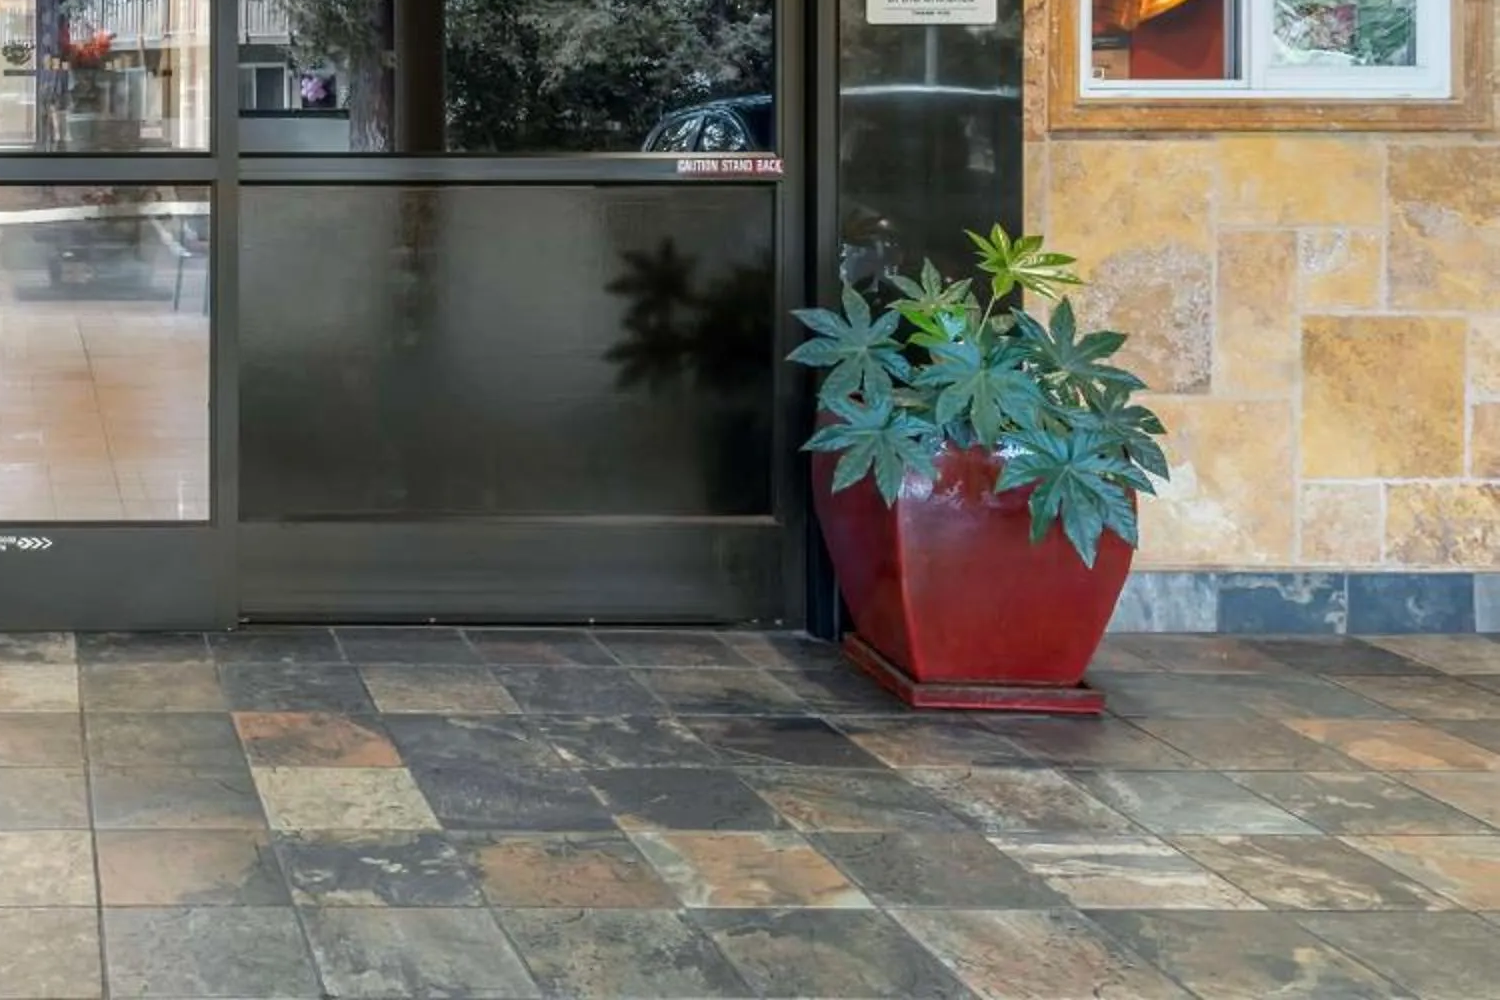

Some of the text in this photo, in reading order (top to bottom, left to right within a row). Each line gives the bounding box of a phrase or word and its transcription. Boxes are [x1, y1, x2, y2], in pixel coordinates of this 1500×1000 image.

[677, 160, 784, 173] CAUTION STAND BACK
